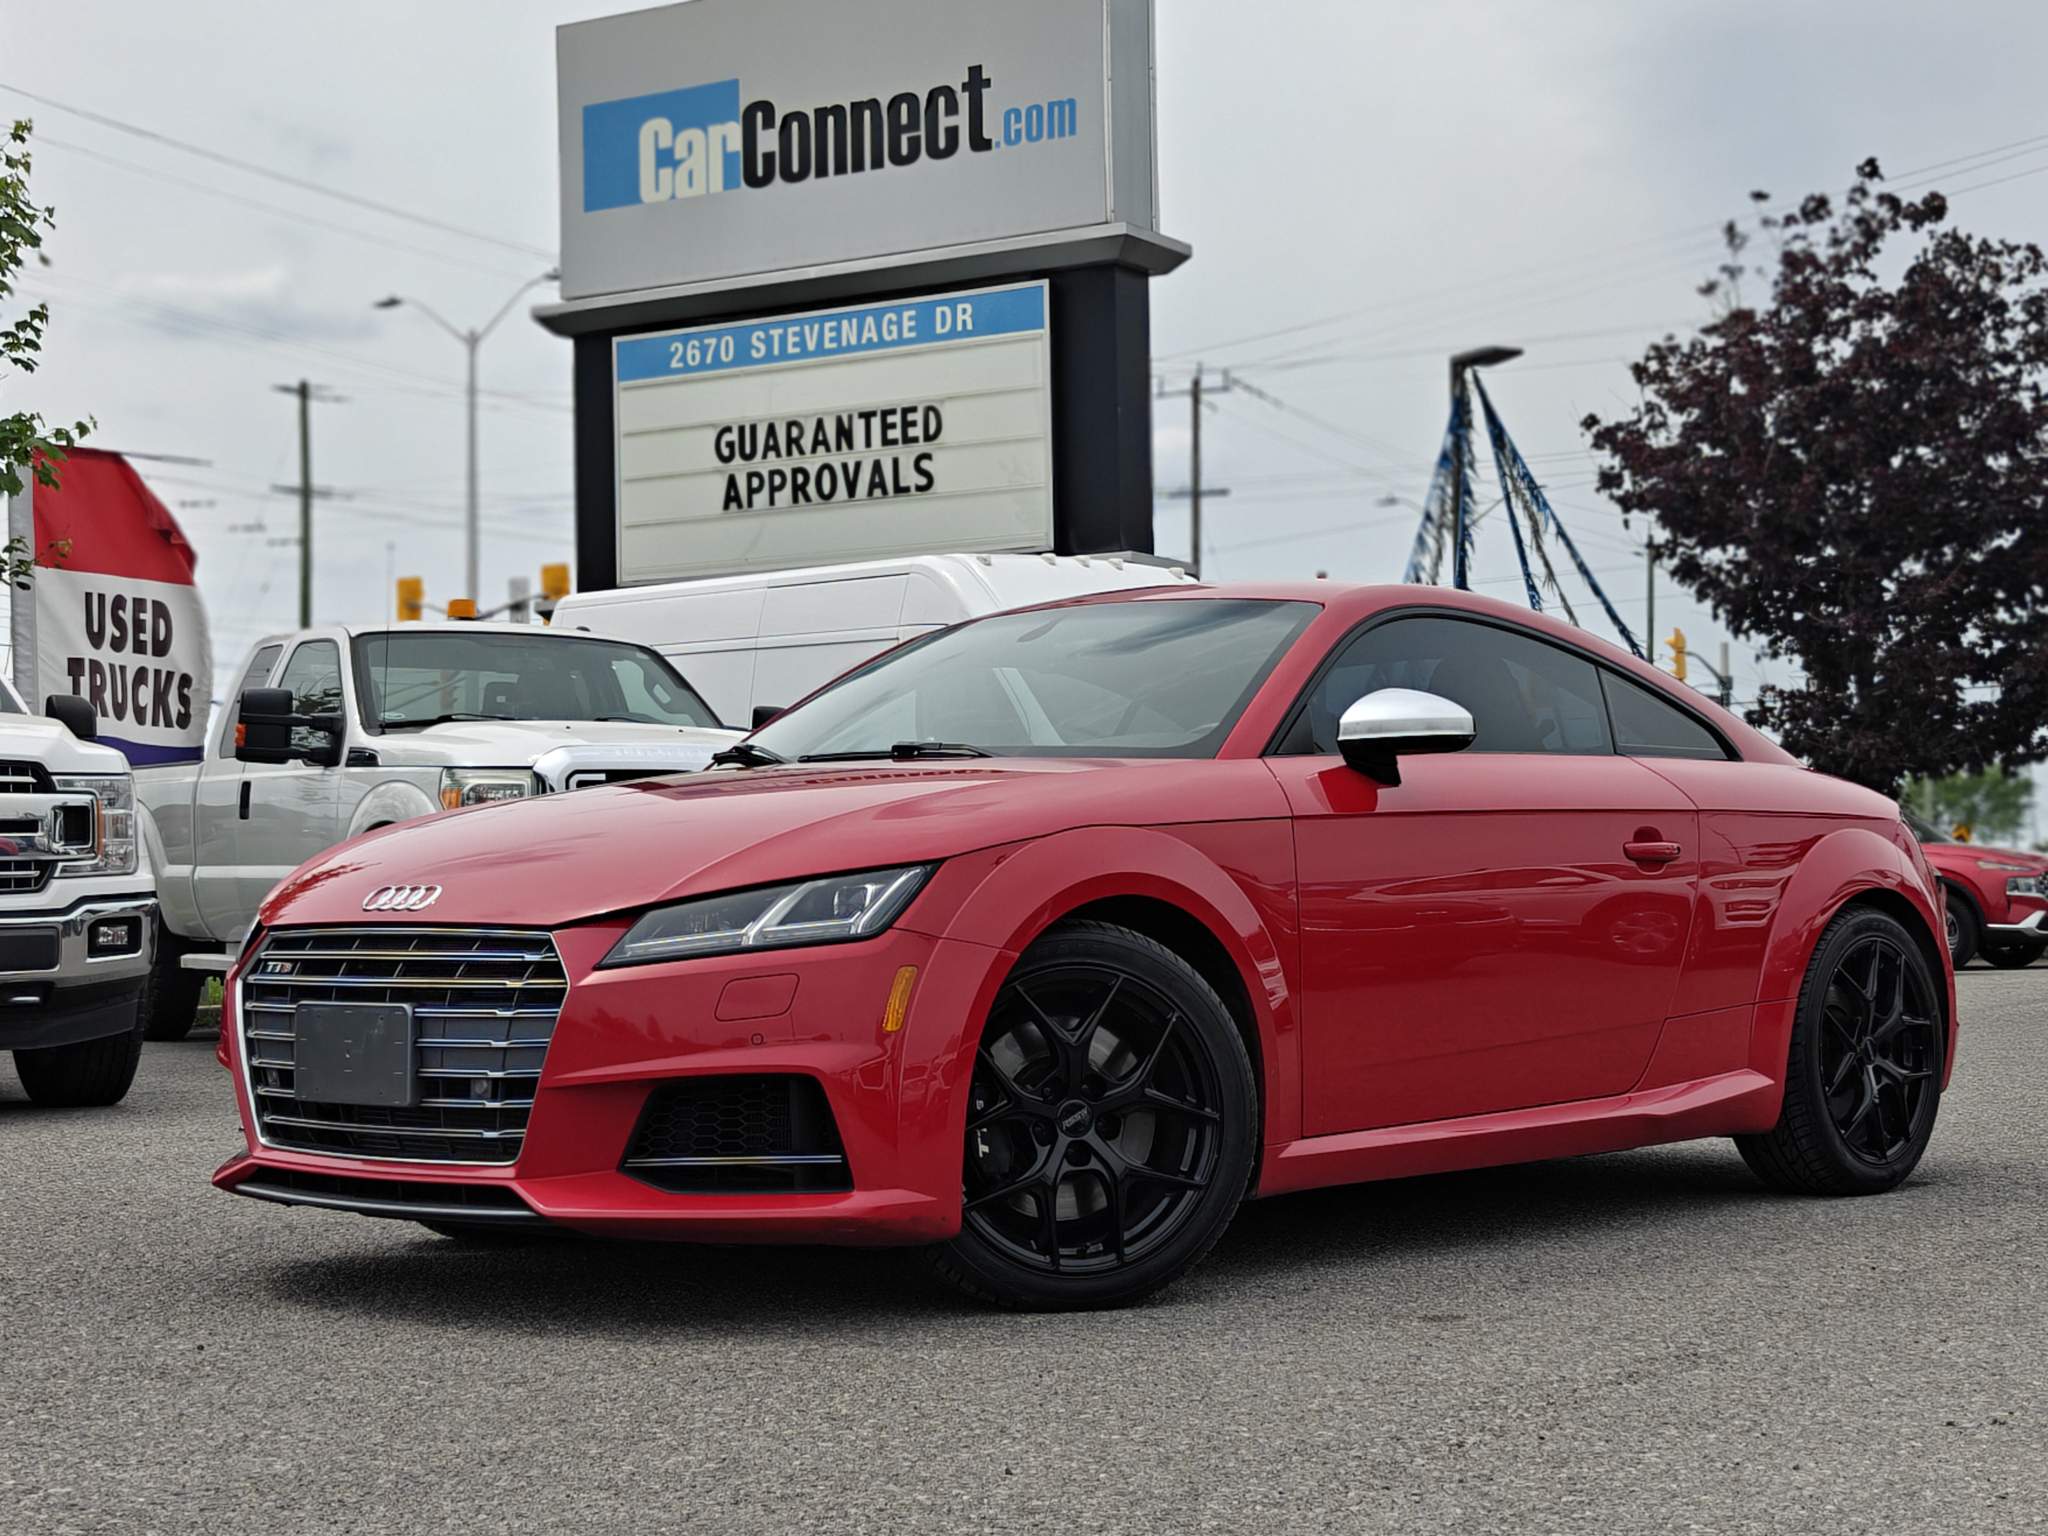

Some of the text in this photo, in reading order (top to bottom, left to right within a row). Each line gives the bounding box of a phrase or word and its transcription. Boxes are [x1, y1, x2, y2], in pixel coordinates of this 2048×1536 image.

[638, 63, 1077, 204] CarConnect.com
[669, 303, 974, 369] 2670 STEVENAGE DR
[714, 405, 943, 464] GUARANTEED
[722, 452, 935, 511] APPROVALS
[85, 591, 173, 657] USED
[67, 657, 193, 730] TRUCKS
